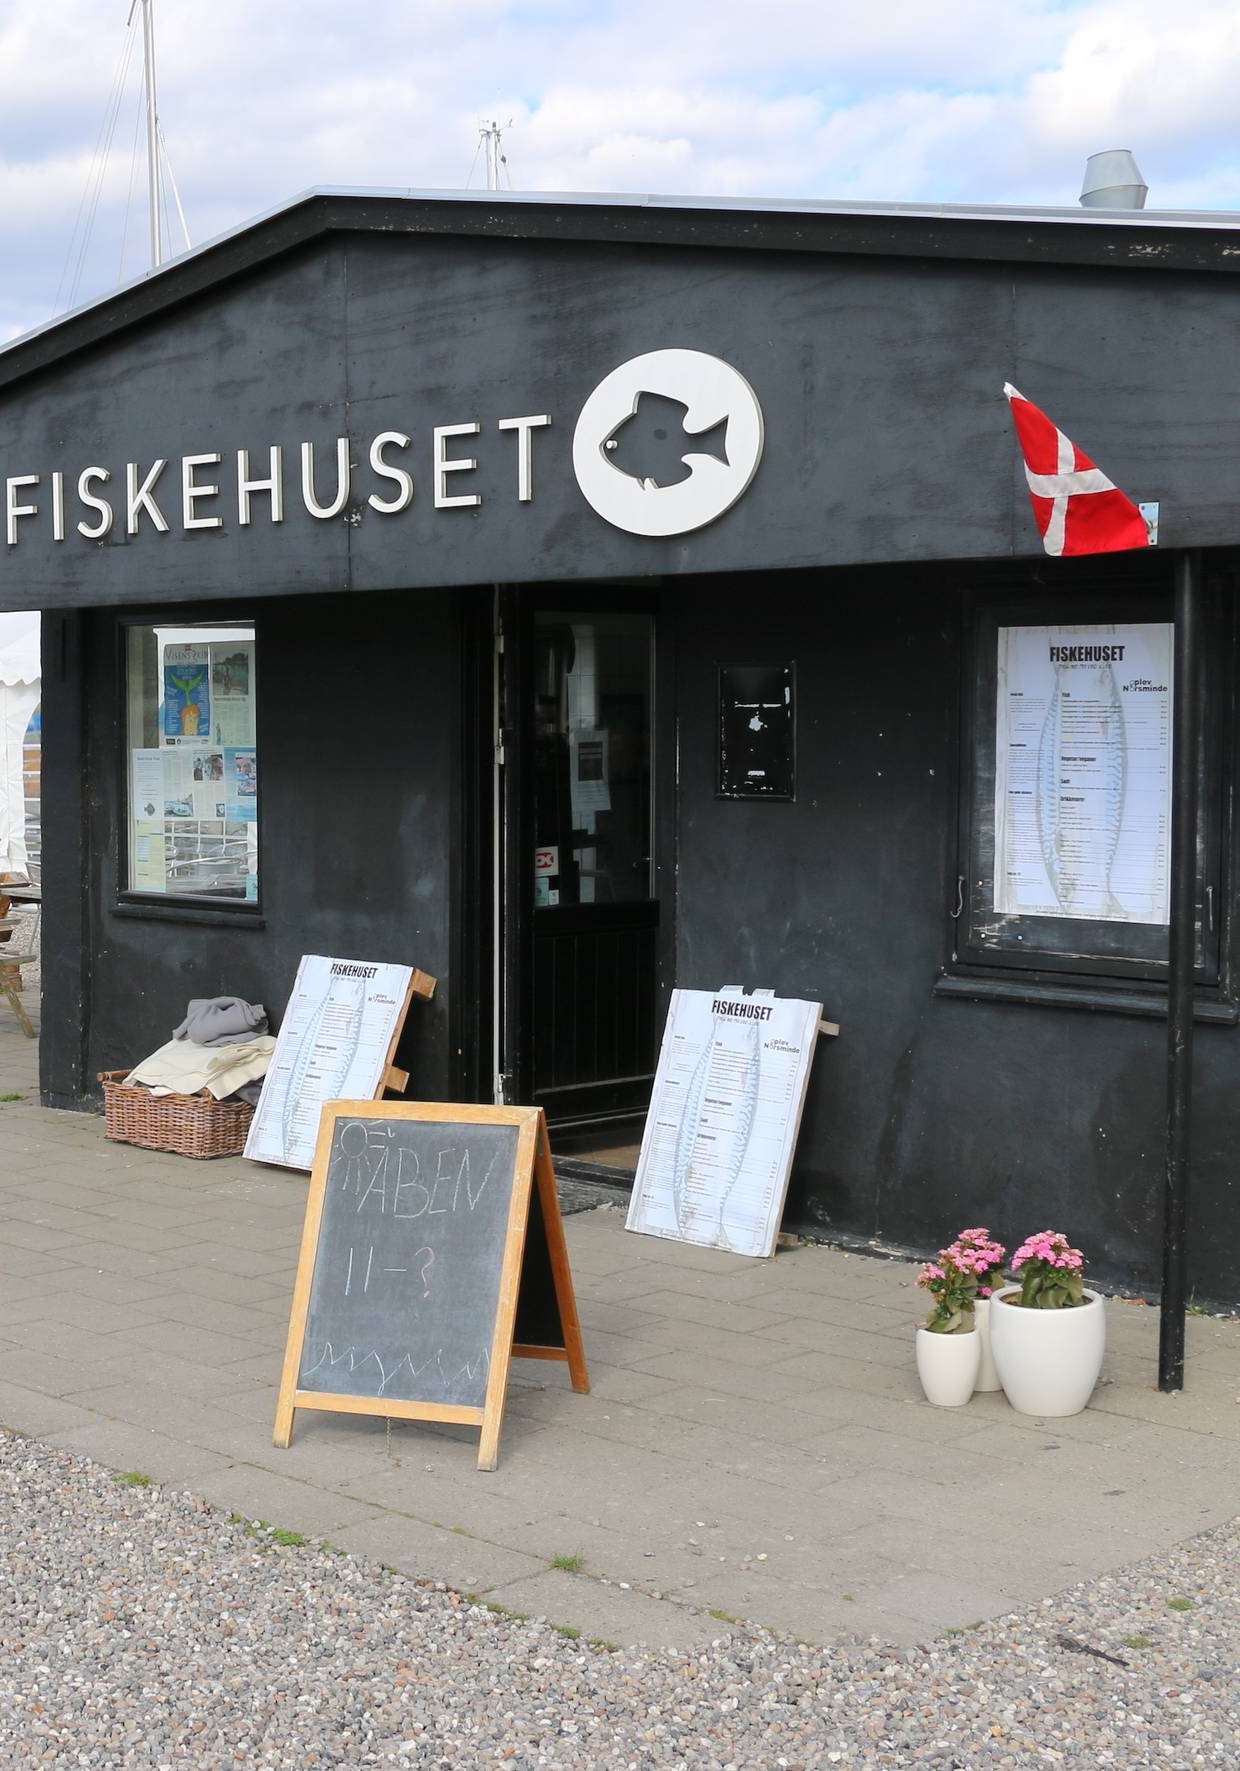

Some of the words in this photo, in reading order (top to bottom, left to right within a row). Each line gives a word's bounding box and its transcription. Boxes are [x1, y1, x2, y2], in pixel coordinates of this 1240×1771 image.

[5, 413, 552, 545] FISKEHUSET
[1049, 645, 1126, 662] FISKEHUSET
[330, 963, 378, 979] FISKEHUSET
[712, 1000, 774, 1021] FISKEHUSET
